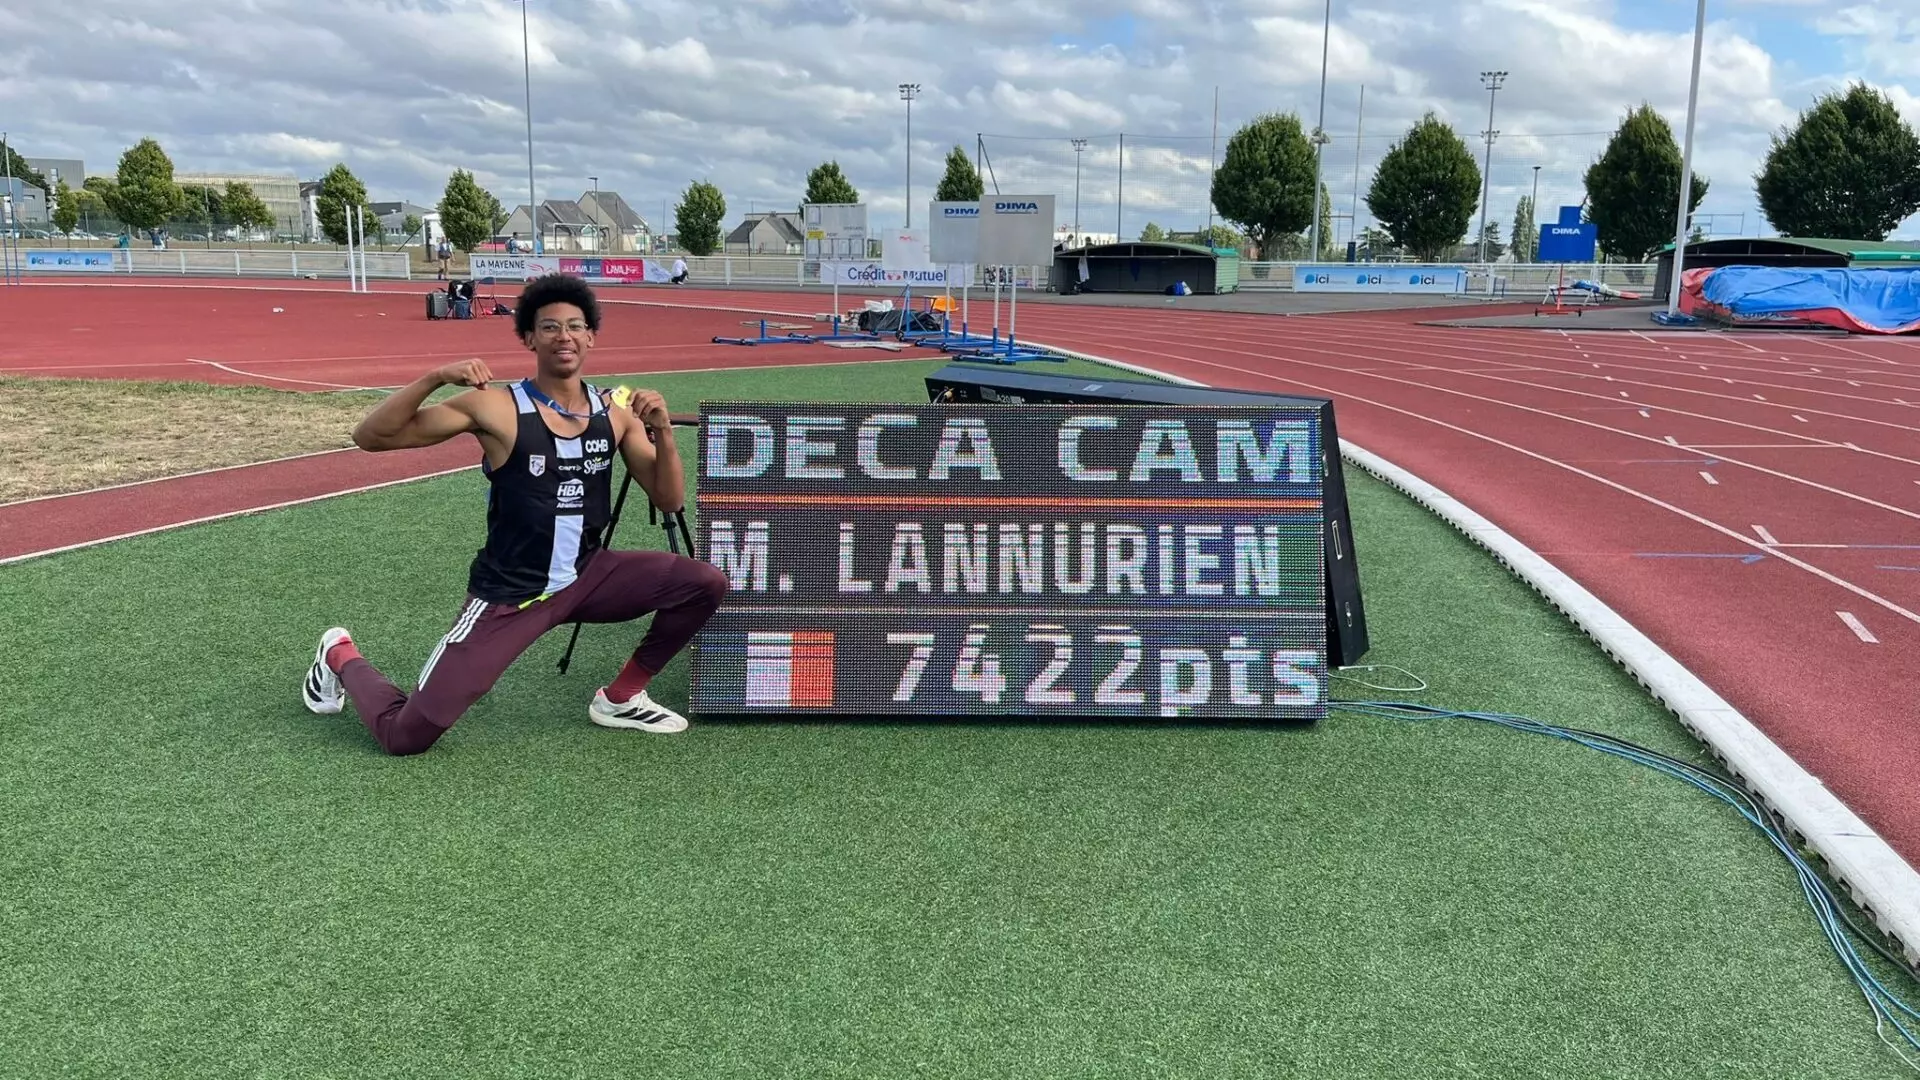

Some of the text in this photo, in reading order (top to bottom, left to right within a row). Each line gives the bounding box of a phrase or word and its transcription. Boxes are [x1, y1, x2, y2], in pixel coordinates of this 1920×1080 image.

[995, 202, 1038, 210] DIMA
[1552, 227, 1580, 235] DIMA
[475, 260, 525, 269] LA MAYENNE
[847, 265, 947, 281] Crédit Mutuel
[1315, 273, 1330, 284] ici
[1367, 273, 1382, 285] ici
[1420, 274, 1435, 285] ici
[706, 414, 1311, 482] DECA CAM
[557, 484, 584, 497] HBA
[710, 521, 1280, 596] M. LANNURIEN
[886, 624, 1320, 717] 7422pts
